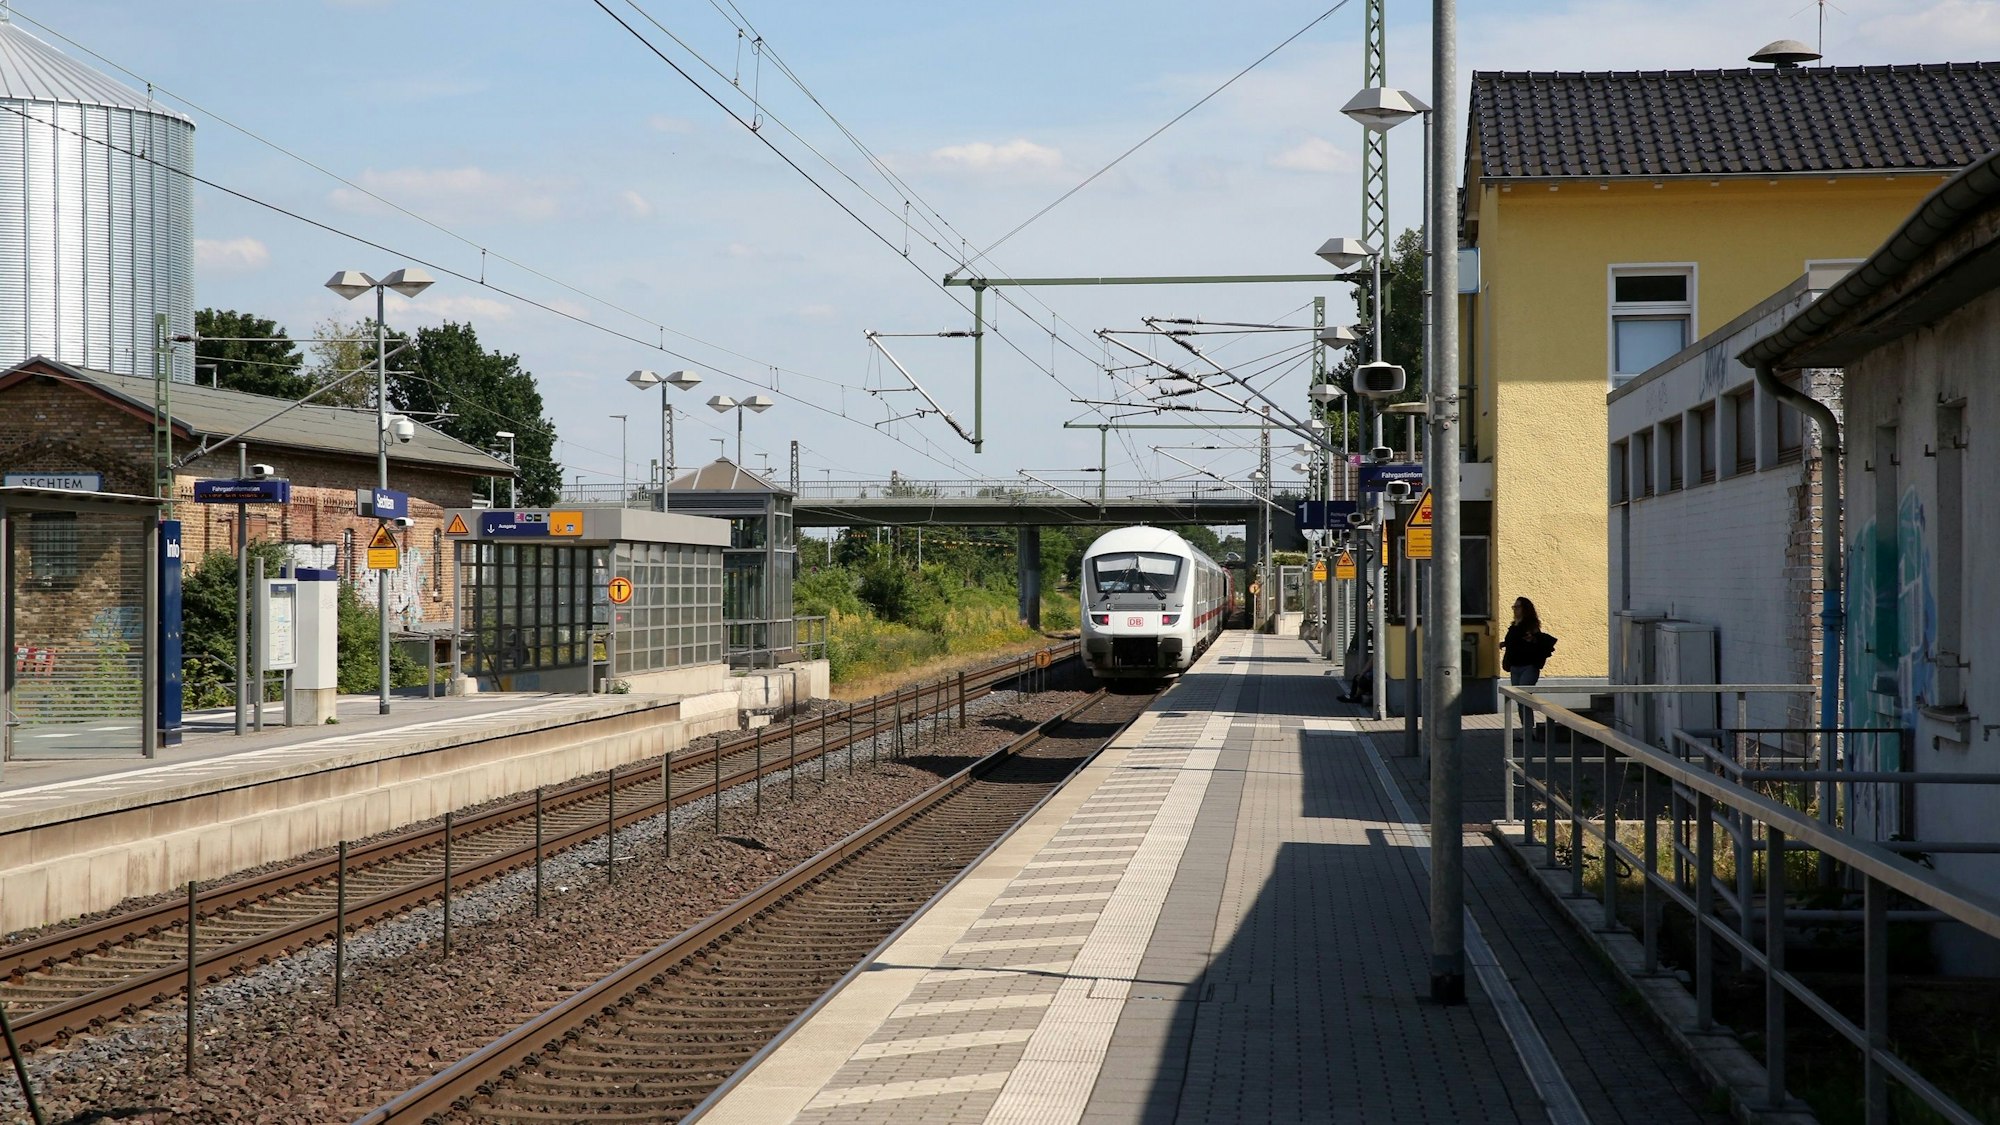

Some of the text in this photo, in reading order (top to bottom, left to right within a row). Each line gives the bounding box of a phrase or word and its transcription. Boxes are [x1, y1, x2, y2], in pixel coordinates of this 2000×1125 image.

[22, 478, 83, 489] SECHTEM
[376, 493, 395, 510] Sechtem
[1298, 502, 1308, 523] 1
[167, 539, 180, 557] Info
[1129, 618, 1142, 626] DB
